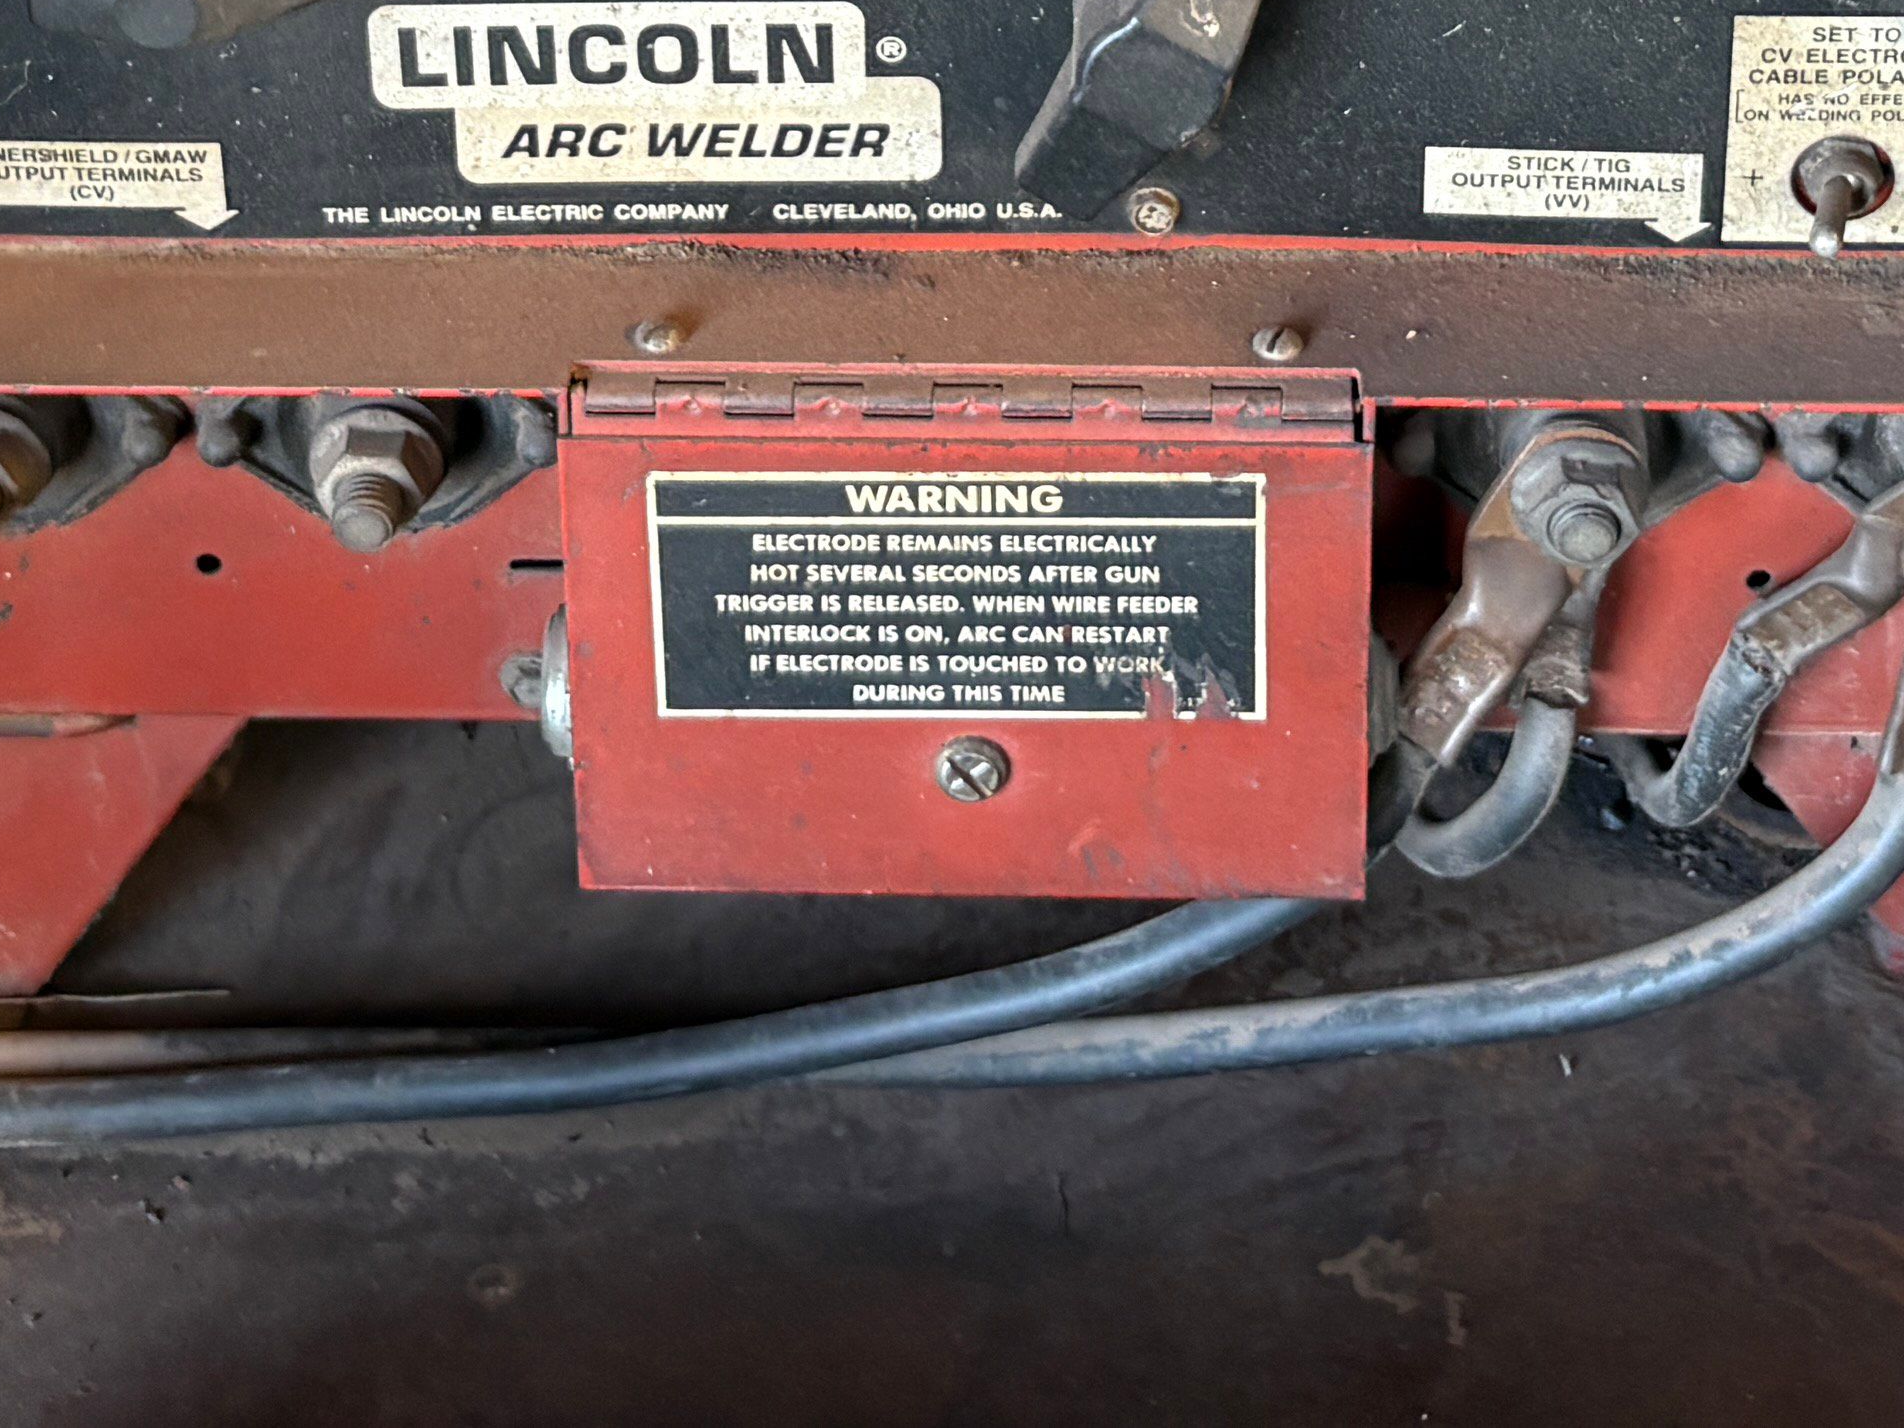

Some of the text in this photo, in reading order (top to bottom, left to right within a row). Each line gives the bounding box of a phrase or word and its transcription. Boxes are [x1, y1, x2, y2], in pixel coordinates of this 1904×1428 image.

[398, 24, 834, 87] LINCOLN
[1749, 69, 1828, 84] CABLE
[502, 123, 890, 158] ARC WELDER
[77, 167, 203, 182] TERMINALS
[1452, 173, 1685, 192] OUTPUT TERMINALS
[70, 185, 115, 202] (CV)
[1545, 194, 1589, 211] (VV)
[322, 203, 1062, 223] THE LINCOLN ELECTRIC COMPANY CLEVELAND, OHIO U.S.A.
[845, 485, 1063, 513] WARNING
[753, 534, 1156, 553] ELECTRODE REMAINS ELECTRICALLY
[751, 564, 1160, 583] HOT SEVERAL SECONDS AFTER GUN
